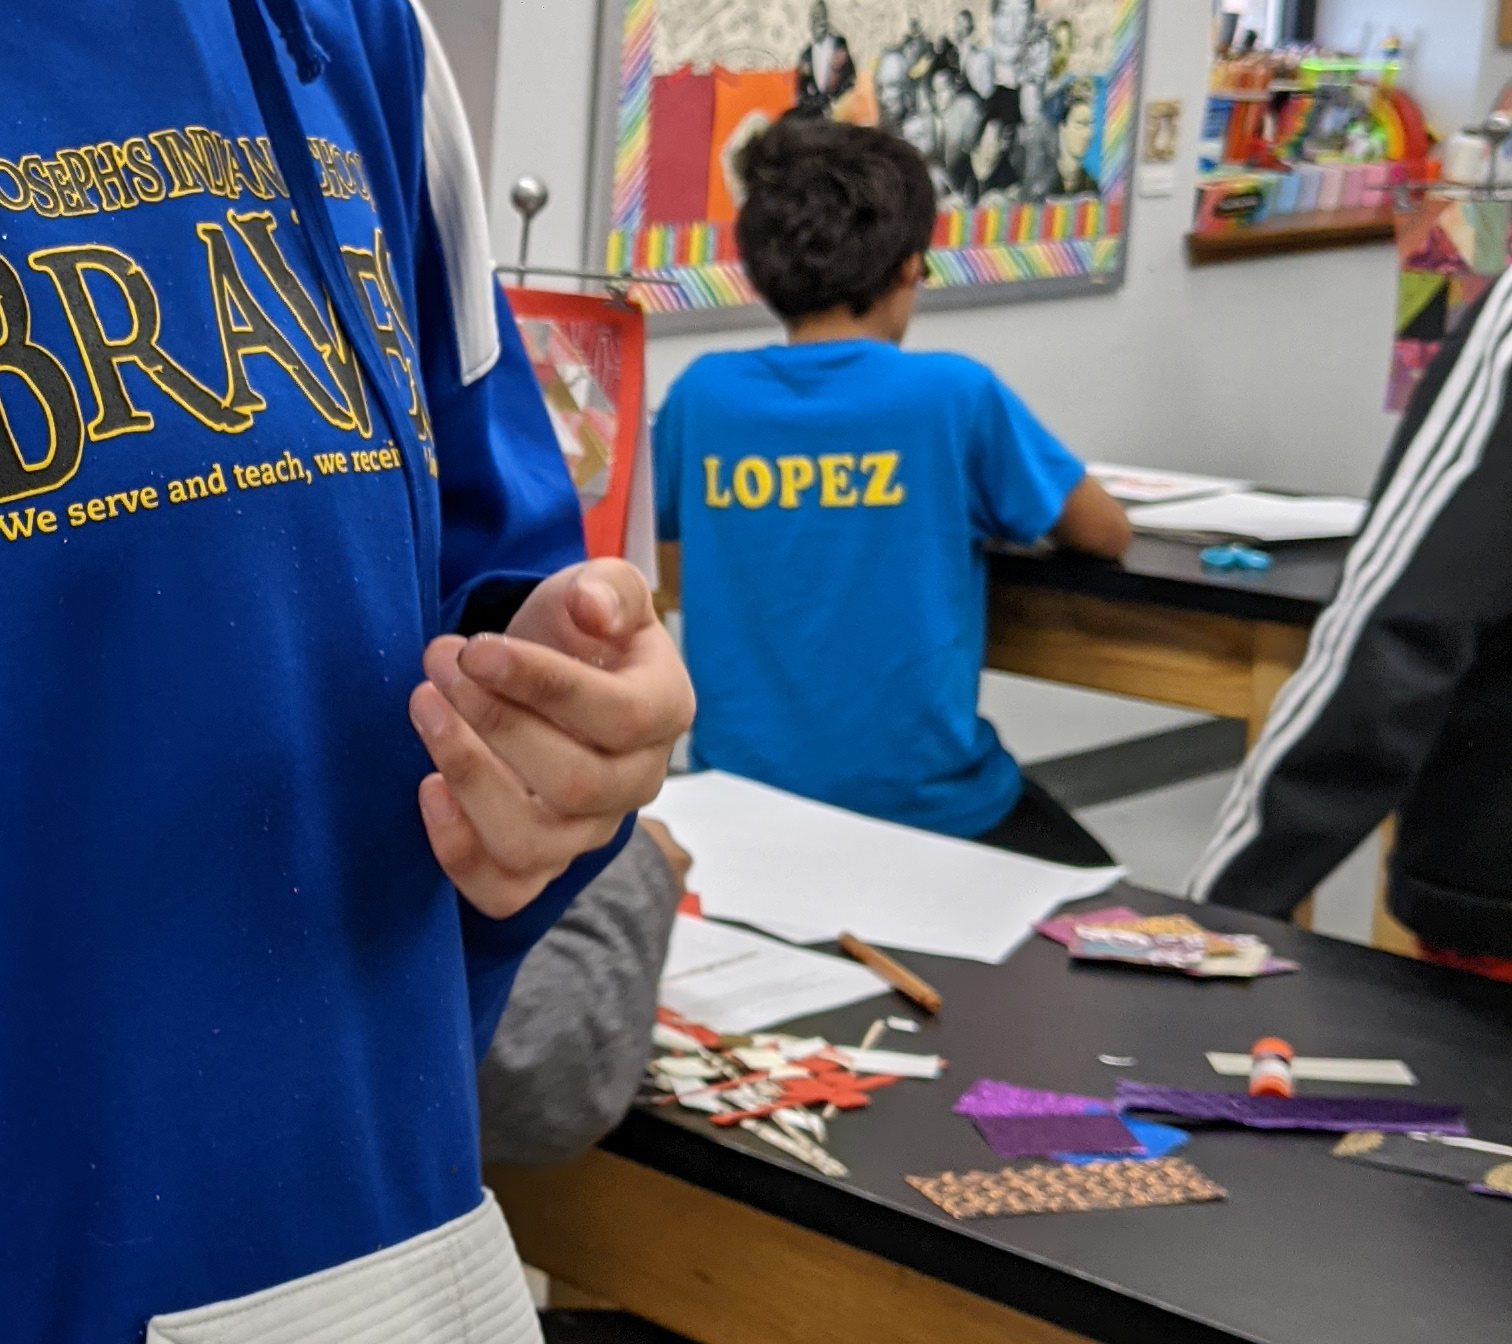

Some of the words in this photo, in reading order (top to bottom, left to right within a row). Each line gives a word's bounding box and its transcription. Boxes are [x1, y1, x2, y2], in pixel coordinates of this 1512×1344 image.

[149, 126, 290, 200] INDIAN
[67, 487, 160, 527] serve
[168, 464, 228, 505] and
[232, 451, 314, 489] teach,
[314, 450, 350, 475] we
[351, 439, 402, 473] recei
[702, 451, 905, 509] LOPEZ
